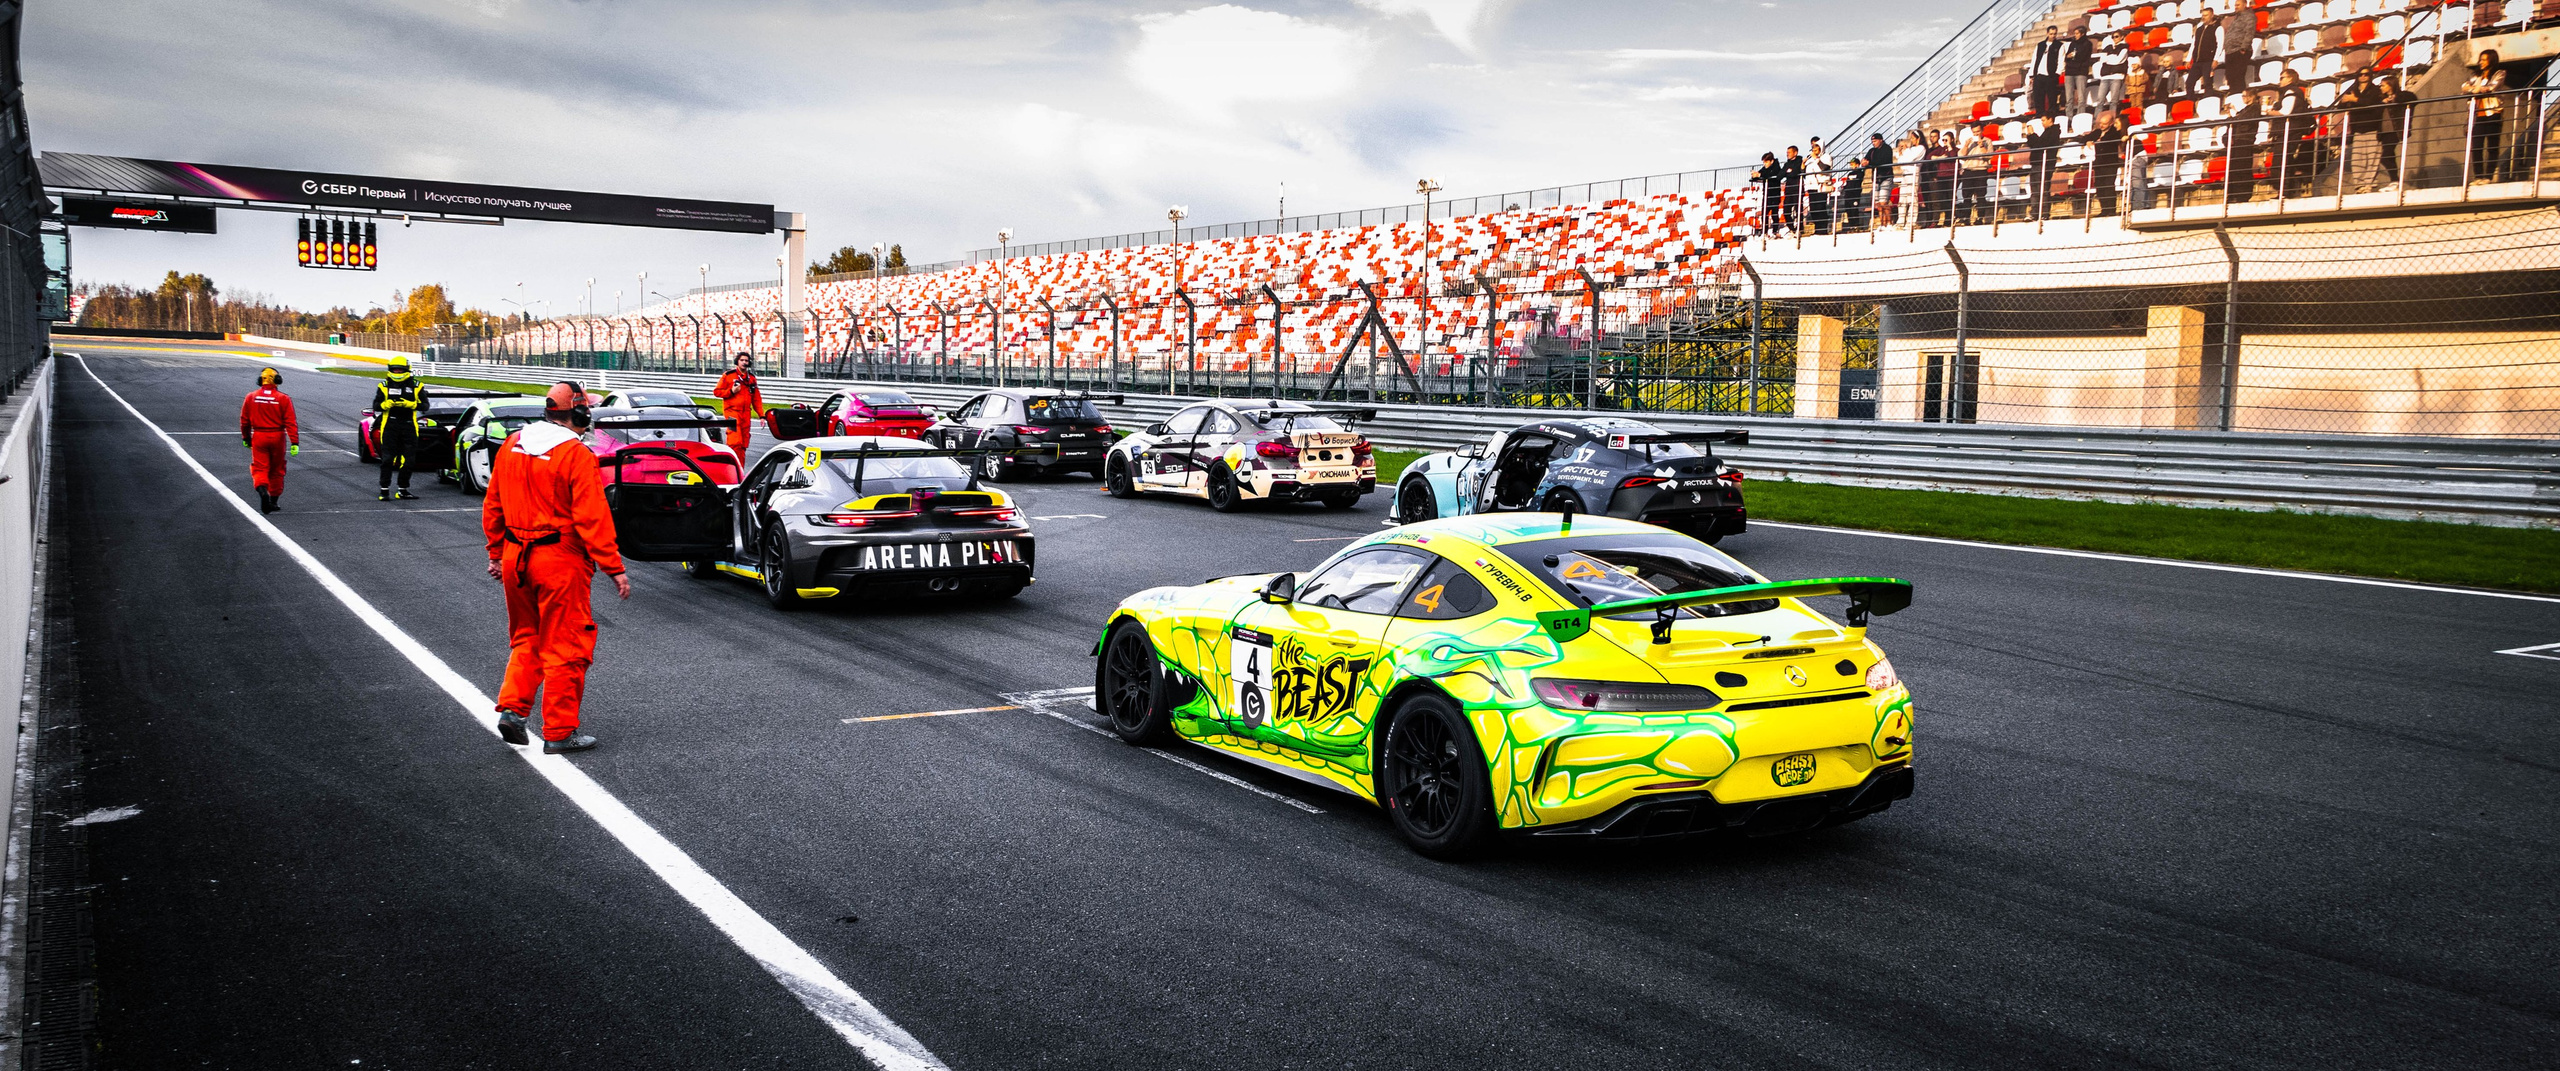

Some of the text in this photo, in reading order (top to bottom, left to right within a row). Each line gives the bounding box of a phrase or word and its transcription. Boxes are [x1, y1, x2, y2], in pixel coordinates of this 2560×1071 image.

[321, 183, 572, 211] СБЕР Первый Искусство получать лучшее
[1573, 447, 1596, 463] 17
[1144, 461, 1154, 474] 29
[1318, 470, 1351, 478] YOKOHAMA
[1560, 465, 1610, 478] ARCTIQUE
[1683, 479, 1714, 487] ARCTIQUE
[864, 540, 1013, 570] ARENA PLAY
[1562, 560, 1607, 579] 4
[1414, 584, 1445, 613] 4
[1553, 617, 1582, 630] GT4
[1279, 635, 1306, 669] the
[1247, 647, 1260, 684] 4
[1272, 656, 1372, 725] BEAST
[1776, 754, 1814, 775] BEAST
